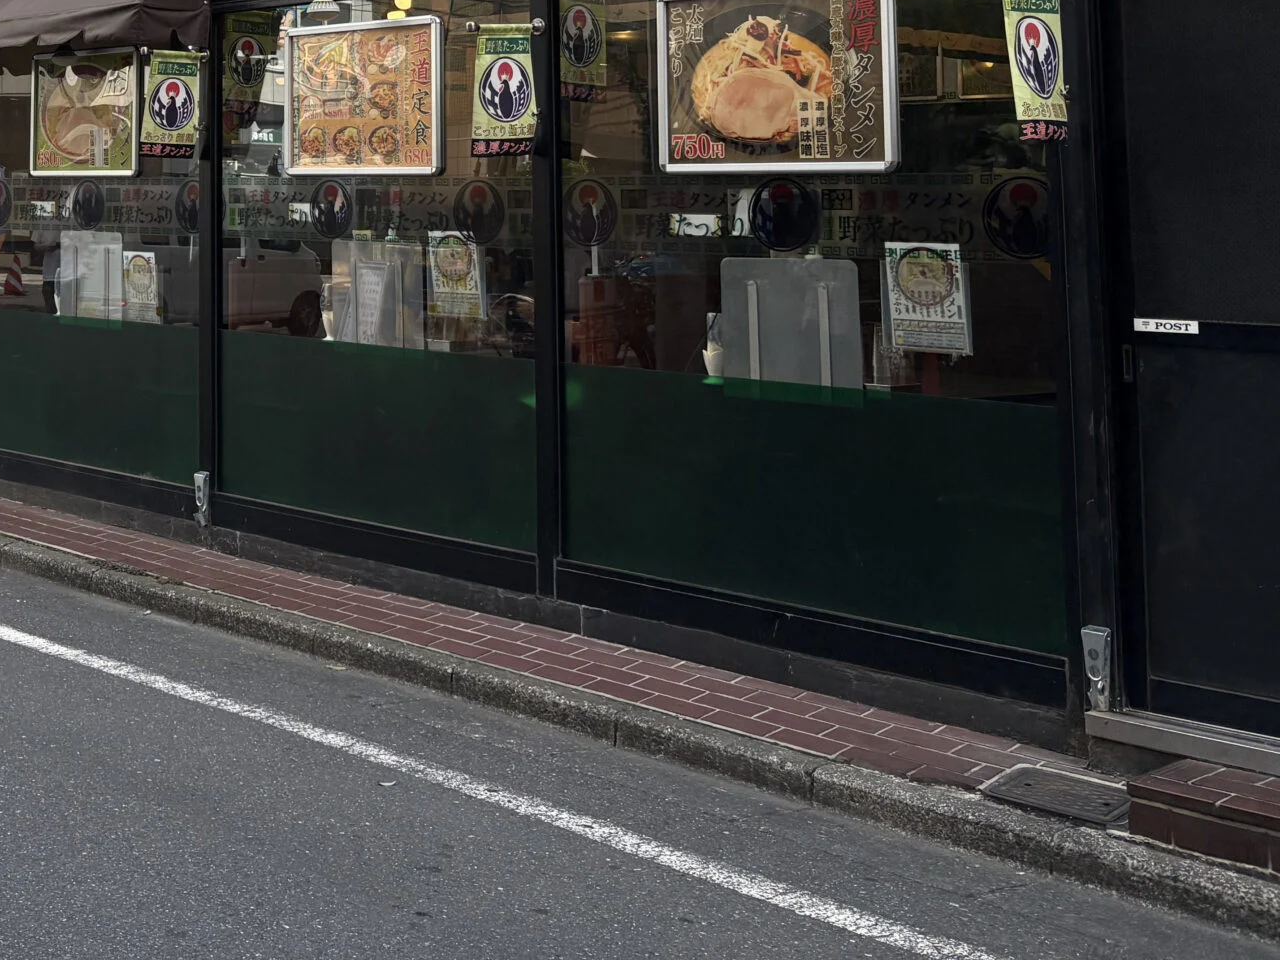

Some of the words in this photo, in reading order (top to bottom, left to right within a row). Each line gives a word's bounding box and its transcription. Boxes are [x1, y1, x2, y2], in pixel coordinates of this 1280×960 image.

[686, 4, 704, 43] 太麺
[410, 30, 432, 146] 王道定食
[141, 144, 194, 156] 王道タンメン
[672, 133, 725, 159] 750円
[1155, 322, 1191, 332] POST
